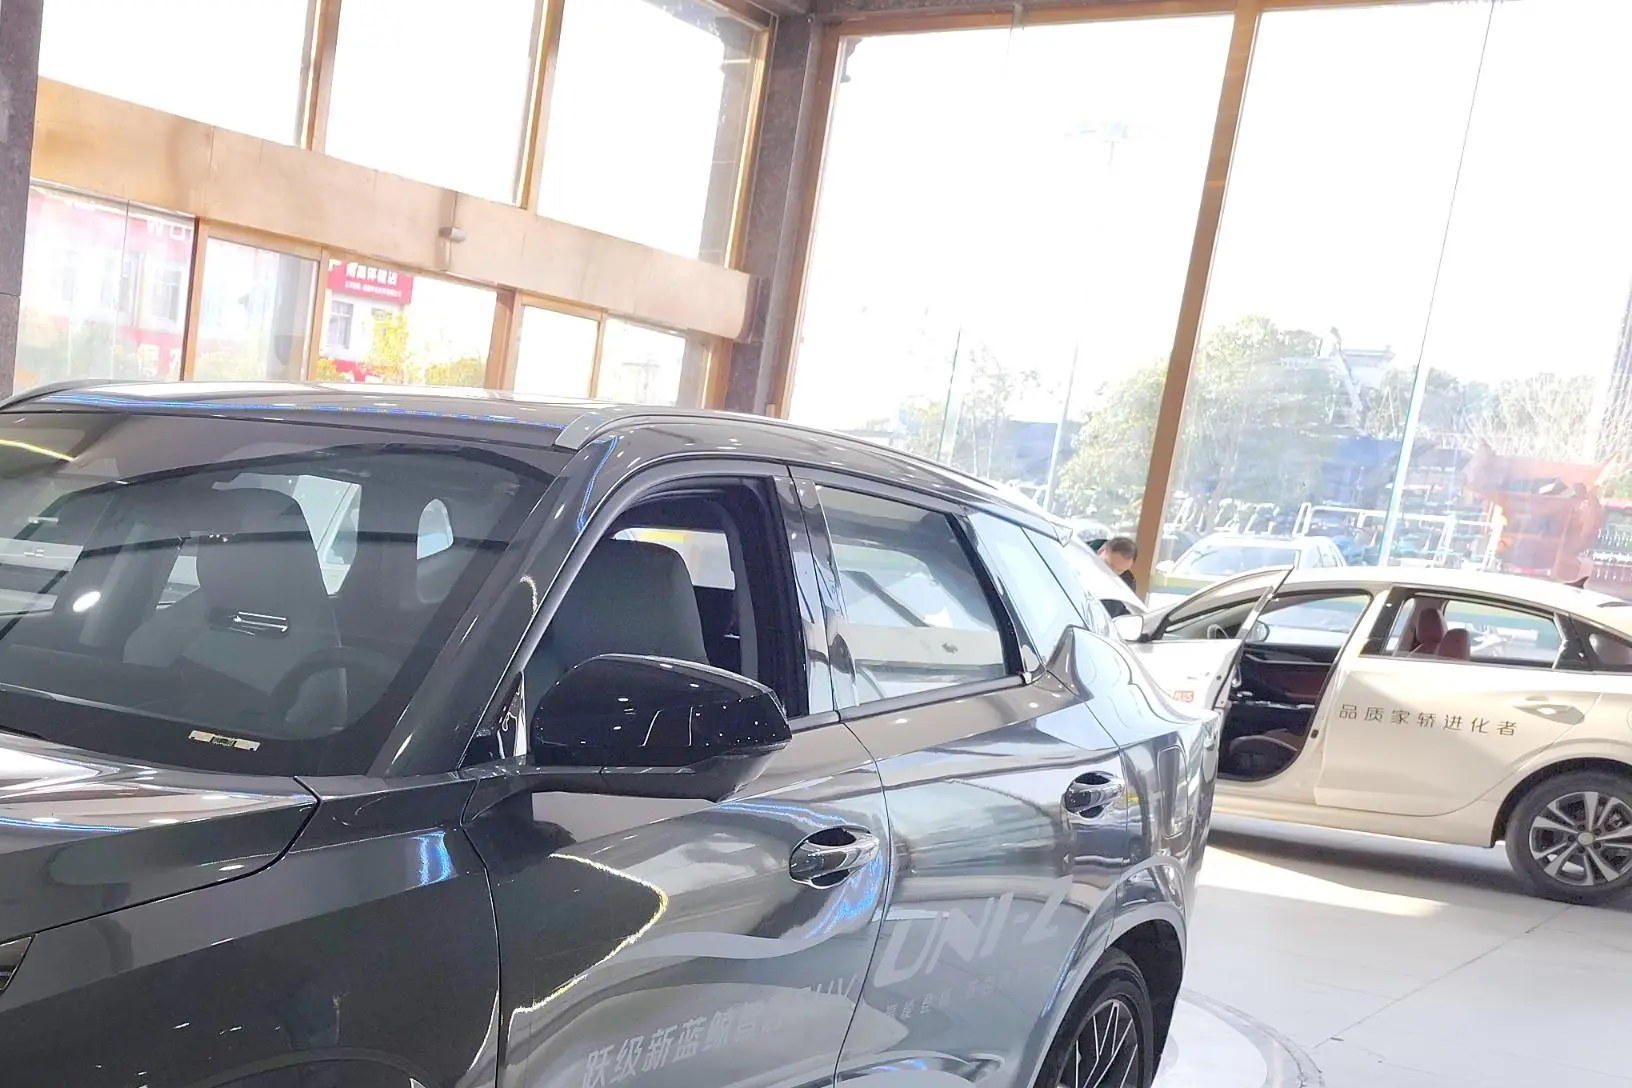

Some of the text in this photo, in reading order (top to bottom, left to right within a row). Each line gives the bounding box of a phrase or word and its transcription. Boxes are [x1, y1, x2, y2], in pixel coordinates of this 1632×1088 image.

[1339, 703, 1517, 737] 品质家轿进化者
